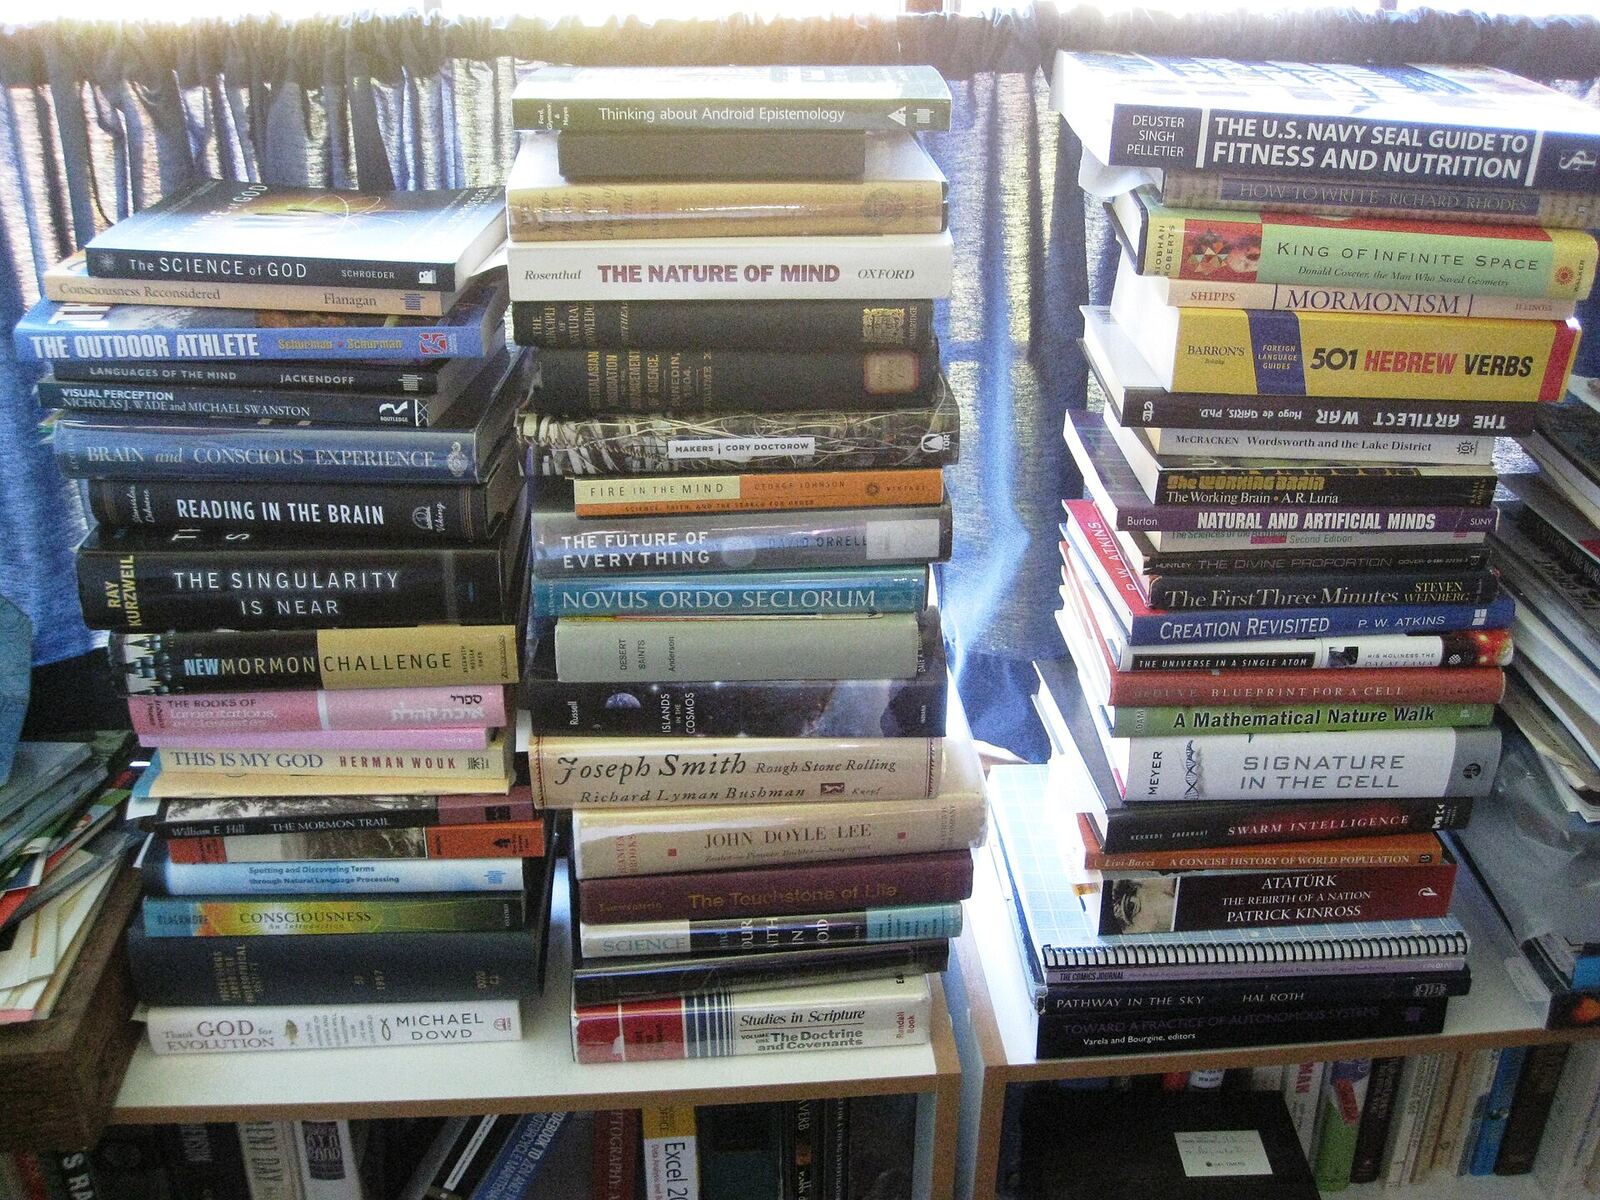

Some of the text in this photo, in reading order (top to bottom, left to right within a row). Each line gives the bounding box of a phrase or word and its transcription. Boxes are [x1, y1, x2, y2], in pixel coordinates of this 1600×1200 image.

[598, 107, 845, 123] Thinking about Android Epistemology
[1132, 114, 1185, 128] DEUSTER
[1139, 129, 1175, 142] SINGH
[1215, 117, 1528, 153] THE U.S. NAVY SEAL GUIDE TO
[1126, 143, 1184, 158] PELLETIER
[1212, 141, 1522, 180] FITNESS AND NUTRITION
[1277, 242, 1539, 271] KING OF INFINITE SPACE
[130, 258, 307, 278] The SCIENCE of GOD
[341, 269, 395, 280] SCHROEDER
[524, 270, 582, 281] Rosenthal
[598, 264, 840, 283] THE NATURE OF MIND
[858, 268, 916, 281] OXFORD
[60, 283, 221, 300] Consciousness Reconsidered
[323, 293, 377, 309] Flanagan
[1190, 289, 1460, 314] SHIPPS MORMONISM
[30, 333, 260, 359] THE OUTDOOR ATHLETE
[1187, 345, 1246, 357] BARRON'S
[1262, 344, 1297, 353] FOREIGN
[1257, 354, 1298, 362] LANGUAGE
[1262, 362, 1292, 370] GUIDES
[1310, 347, 1534, 377] 501 HEBREW VERBS
[89, 367, 237, 380] LANGUAGES OF THE MIND
[280, 374, 354, 384] JACKENDOFF
[61, 388, 174, 400] VISUAL PERCEPTION
[675, 445, 714, 453] MAKERS
[726, 442, 809, 452] CORY DOCTOROW
[1176, 435, 1433, 452] McCRACKEN Wordsworth and the Lake District
[87, 446, 437, 467] BRAIN and CONSCIOUS EXPERIENCE
[177, 498, 384, 525] READING IN THE BRAIN
[1127, 512, 1437, 530] Burton NATURAL AND ARTIFICIAL MINDS
[561, 531, 709, 550] THE FUTURE OF
[563, 550, 711, 568] EVERYTHING
[174, 572, 399, 589] THE SINGULARITY
[1414, 581, 1464, 593] STEVEN
[105, 581, 121, 609] RAY
[120, 554, 143, 627] KURZWEIL
[1164, 586, 1400, 607] The First Three Minutes
[1404, 592, 1471, 601] WEINBERG
[241, 600, 339, 615] IS NEAR
[562, 590, 876, 609] NOVUS ORDO SECLORUM
[1159, 617, 1331, 640] CREATION REVISITED
[619, 638, 628, 670] DESERT
[638, 639, 646, 670] SAINTS
[183, 653, 452, 677] NEW MORMON CHALLENGE
[661, 693, 671, 734] ISLANDS
[685, 692, 696, 734] COSMOS
[1172, 706, 1436, 729] A Mathematical Nature Walk
[169, 752, 324, 768] THIS IS MY GOD
[340, 756, 456, 769] HERMAN WOUK
[1242, 755, 1406, 771] SIGNATURE
[554, 753, 897, 785] Joseph Smith Rough Stone Rolling
[1147, 751, 1163, 796] MEYER
[1239, 774, 1401, 790] IN THE CELL
[580, 787, 806, 804] Richard Lyman Bushman
[1227, 814, 1410, 837] SWARM INTELLIGENCE
[703, 823, 873, 850] JOHN DOYLE LEE
[1261, 873, 1338, 890] ATATÜRK
[239, 911, 372, 924] CONSCIOUSNESS
[1226, 905, 1362, 923] PATRICK KINROSS
[396, 1012, 485, 1027] MICHAEL
[740, 1008, 866, 1027] Studies in Scripture
[411, 1029, 473, 1041] DOWD
[770, 1028, 864, 1043] The Doctrine
[1082, 1032, 1197, 1046] Varela and Bourgine, editors
[167, 1037, 275, 1051] EVOLUTION
[757, 1036, 864, 1052] and Covenants
[664, 1141, 687, 1181] Excel
